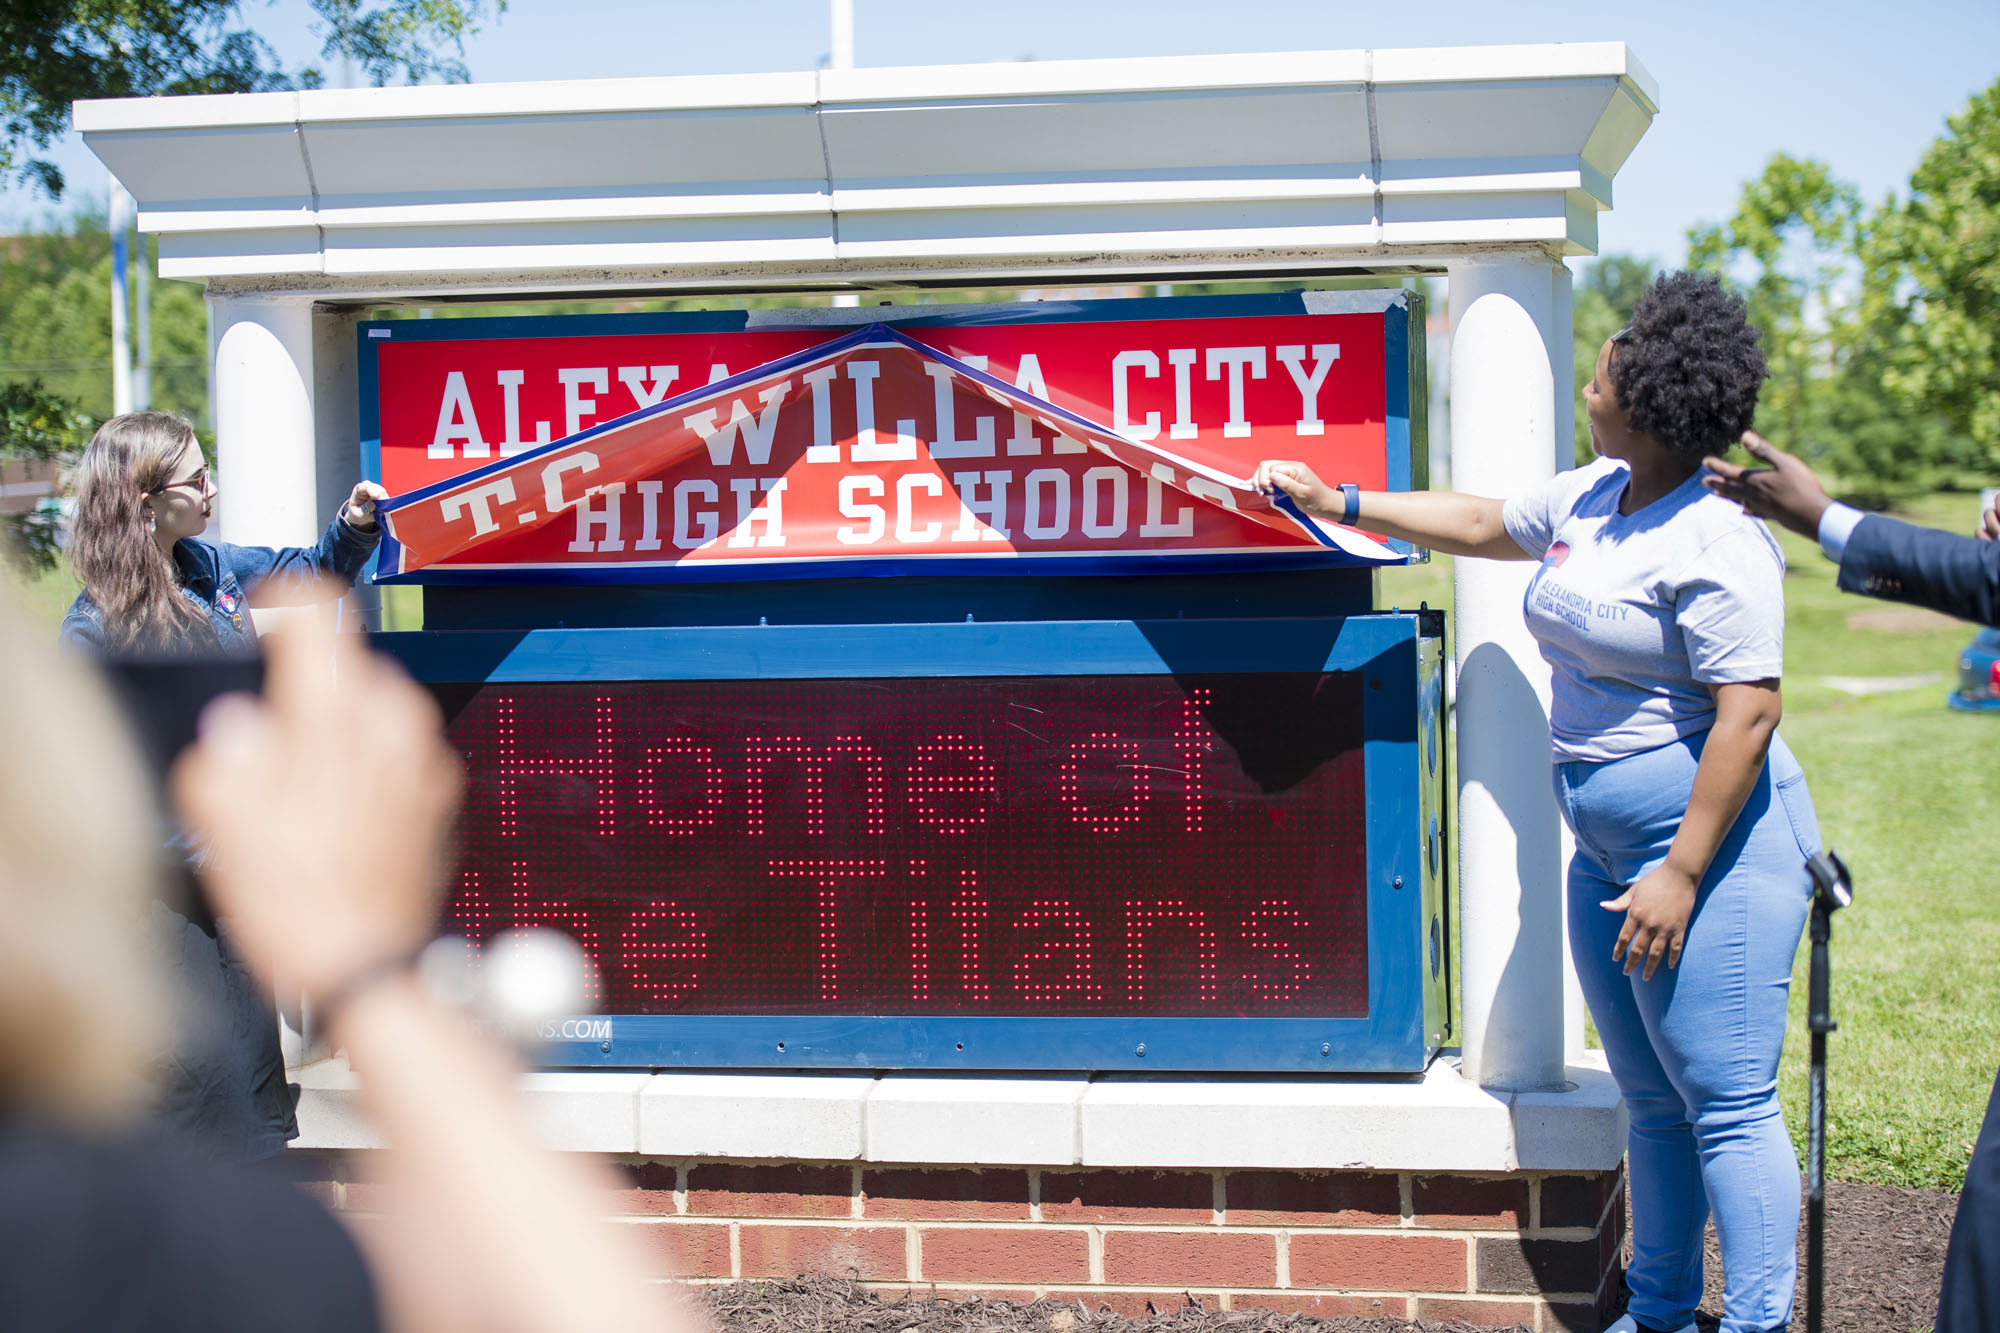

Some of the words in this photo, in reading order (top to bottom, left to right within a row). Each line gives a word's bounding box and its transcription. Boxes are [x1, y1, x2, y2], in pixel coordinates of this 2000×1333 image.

[1112, 343, 1341, 441] CITY
[568, 477, 788, 553] HIGH
[837, 465, 1194, 546] SCHOOL
[1535, 592, 1554, 612] HIGH
[1555, 603, 1591, 632] SCHOOL
[1541, 579, 1592, 616] ALEXANDRIA
[1597, 603, 1629, 621] CITY
[498, 696, 995, 836] Home
[1061, 689, 1212, 833] of
[455, 860, 708, 999] the
[768, 859, 1311, 999] Titans
